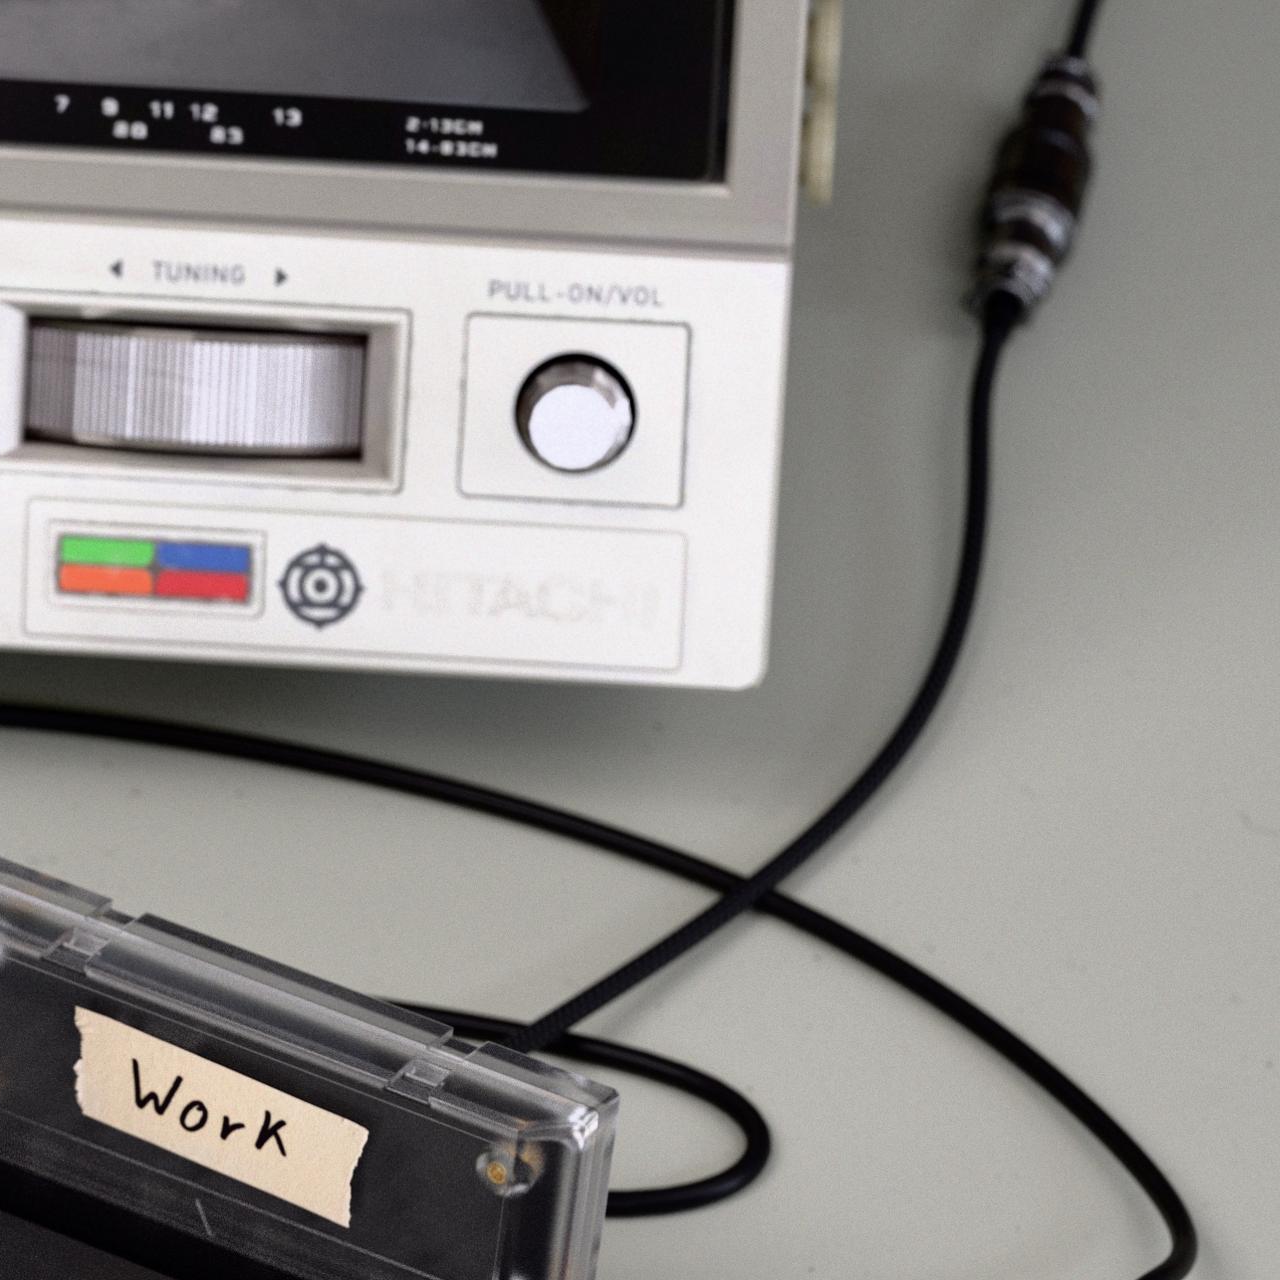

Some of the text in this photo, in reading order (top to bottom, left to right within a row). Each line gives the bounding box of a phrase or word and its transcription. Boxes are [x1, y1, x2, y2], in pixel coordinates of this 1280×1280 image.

[150, 101, 174, 119] 11
[191, 103, 218, 122] 12
[274, 108, 302, 127] 13
[153, 260, 245, 284] TUNING
[487, 279, 661, 307] PULL-ON/VOL
[131, 1058, 287, 1157] Work
